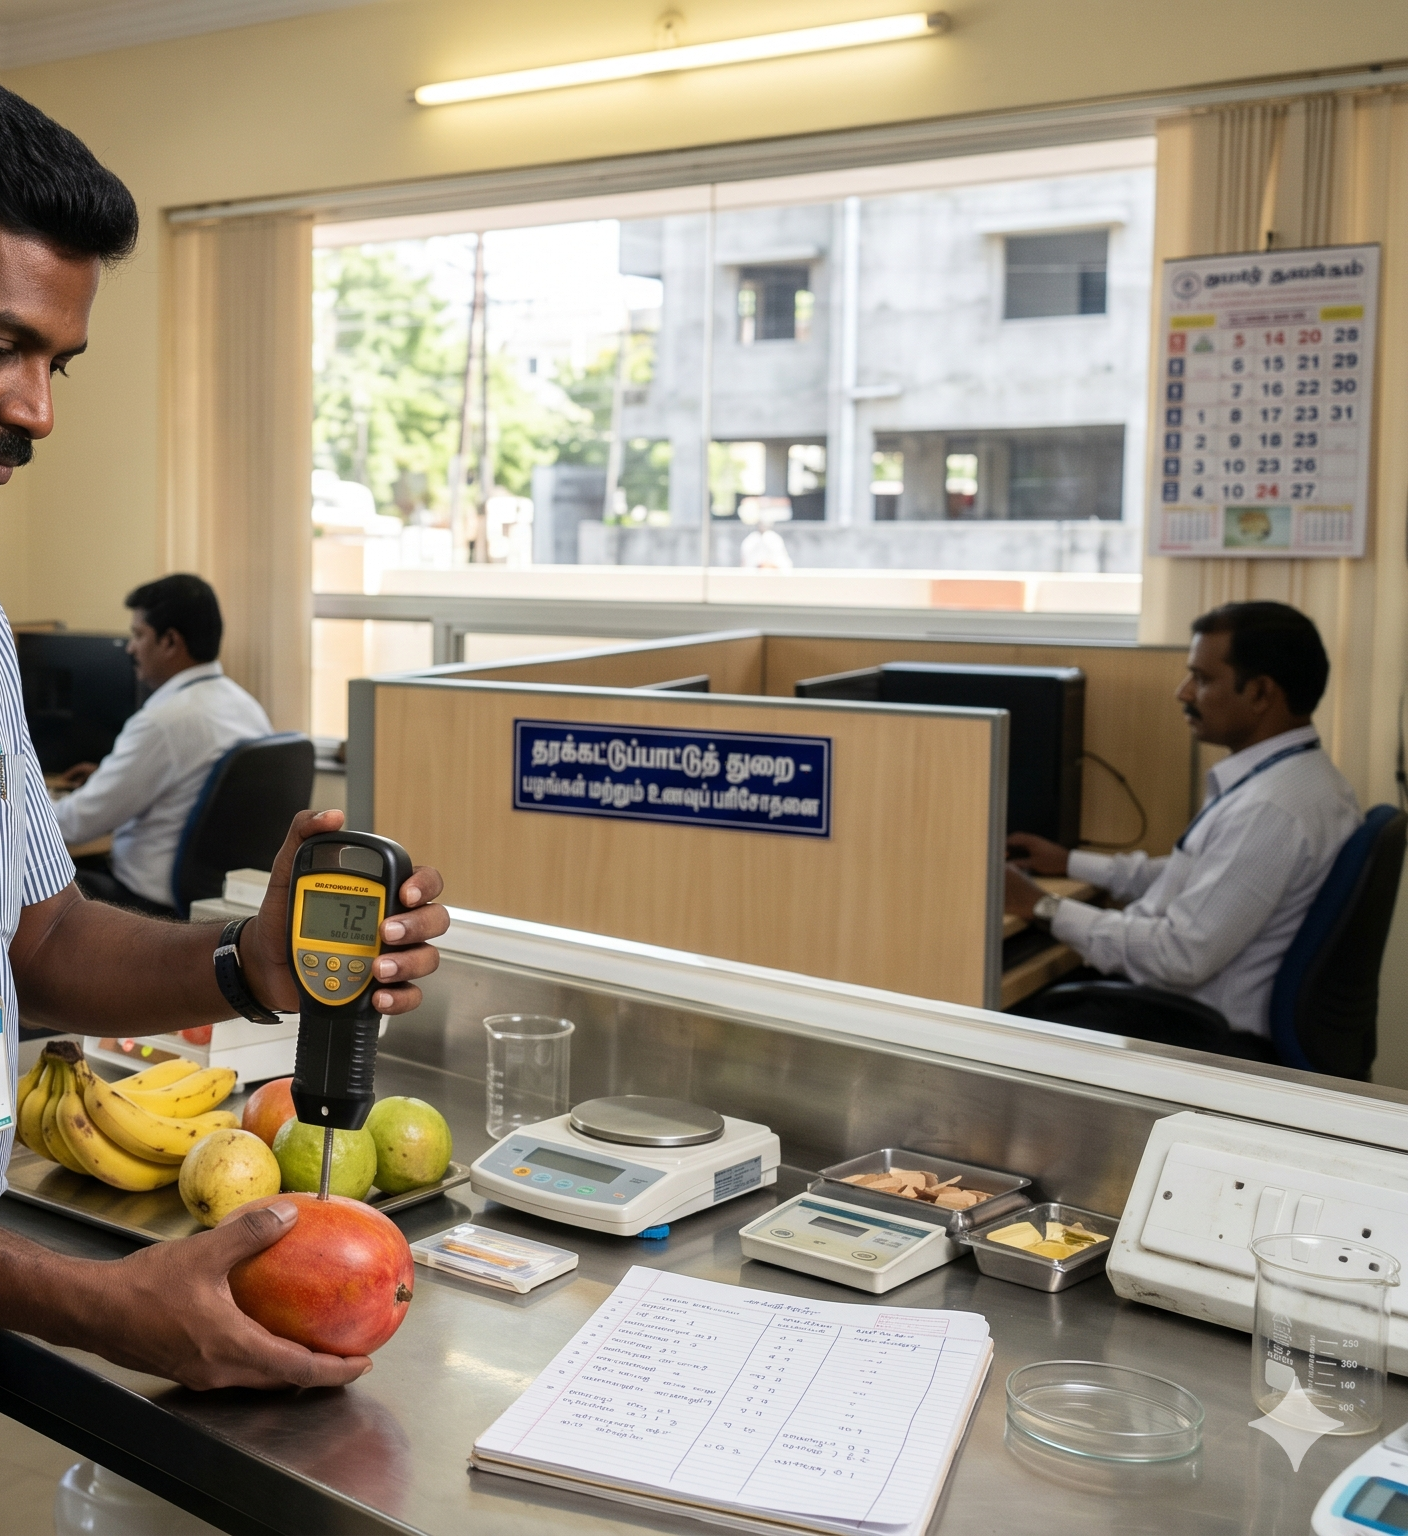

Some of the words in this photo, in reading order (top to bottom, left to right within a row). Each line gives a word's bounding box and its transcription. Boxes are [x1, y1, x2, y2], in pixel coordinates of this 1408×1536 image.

[1263, 332, 1285, 346] 14
[1298, 329, 1322, 345] 20
[1232, 358, 1244, 373] 6
[1262, 356, 1284, 372] 15
[1297, 354, 1320, 370] 21
[1333, 353, 1358, 369] 29
[1261, 381, 1283, 397] 16
[1295, 379, 1320, 396] 22
[1331, 378, 1357, 394] 30
[1197, 407, 1205, 424] 1
[1260, 406, 1282, 422] 17
[1294, 405, 1319, 422] 23
[1330, 405, 1353, 422] 31
[1194, 434, 1207, 450] 2
[1229, 433, 1242, 449] 9
[1293, 432, 1318, 448] 25
[1193, 459, 1205, 476] 3
[1223, 458, 1246, 474] 10
[1256, 458, 1280, 474] 23
[1292, 457, 1317, 473] 26
[1191, 484, 1204, 500] 4
[1222, 484, 1244, 499] 10
[1256, 483, 1280, 499] 24
[1290, 482, 1315, 499] 27
[531, 733, 721, 778] தரக்கட்டுப்பாட்டுத்
[725, 752, 796, 786] துறை
[522, 771, 587, 801] பழங்கள்
[588, 776, 645, 808] மற்றும்
[647, 782, 711, 813] உணவுப்
[713, 785, 821, 820] பரிசோதனை
[339, 902, 367, 932] 72
